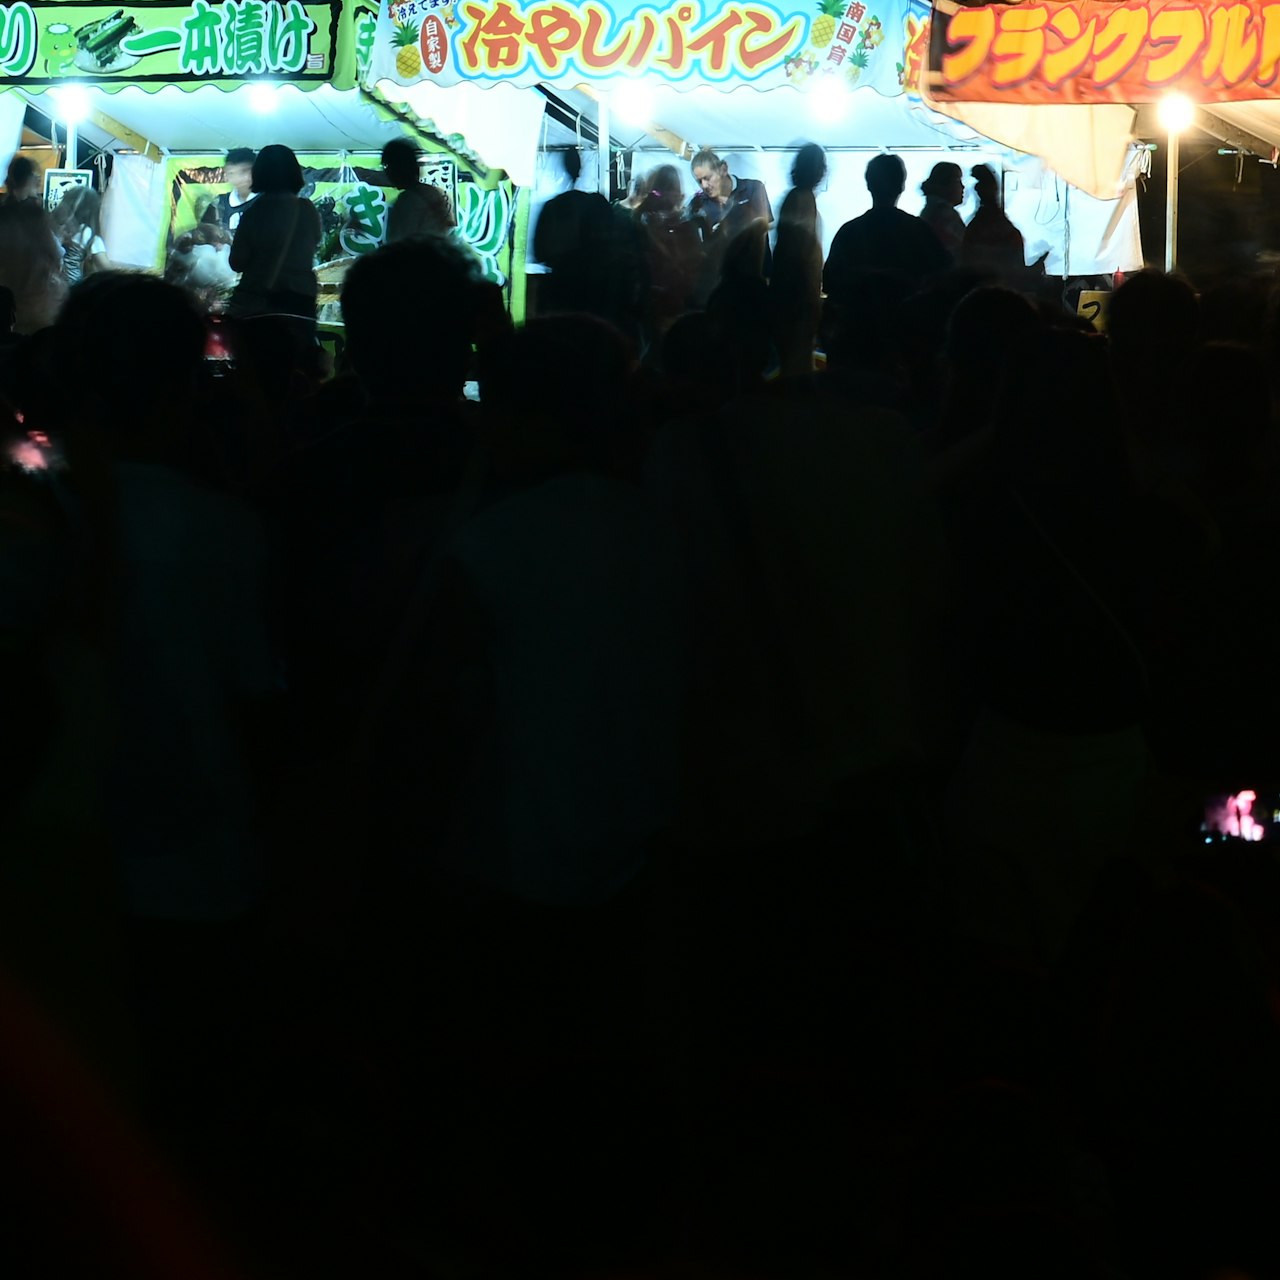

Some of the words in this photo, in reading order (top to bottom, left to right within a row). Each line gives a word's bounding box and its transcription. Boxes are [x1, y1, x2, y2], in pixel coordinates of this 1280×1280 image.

[425, 20, 443, 69] 自家製
[461, 0, 802, 70] 冷やしパイン
[822, 1, 866, 76] 南国育
